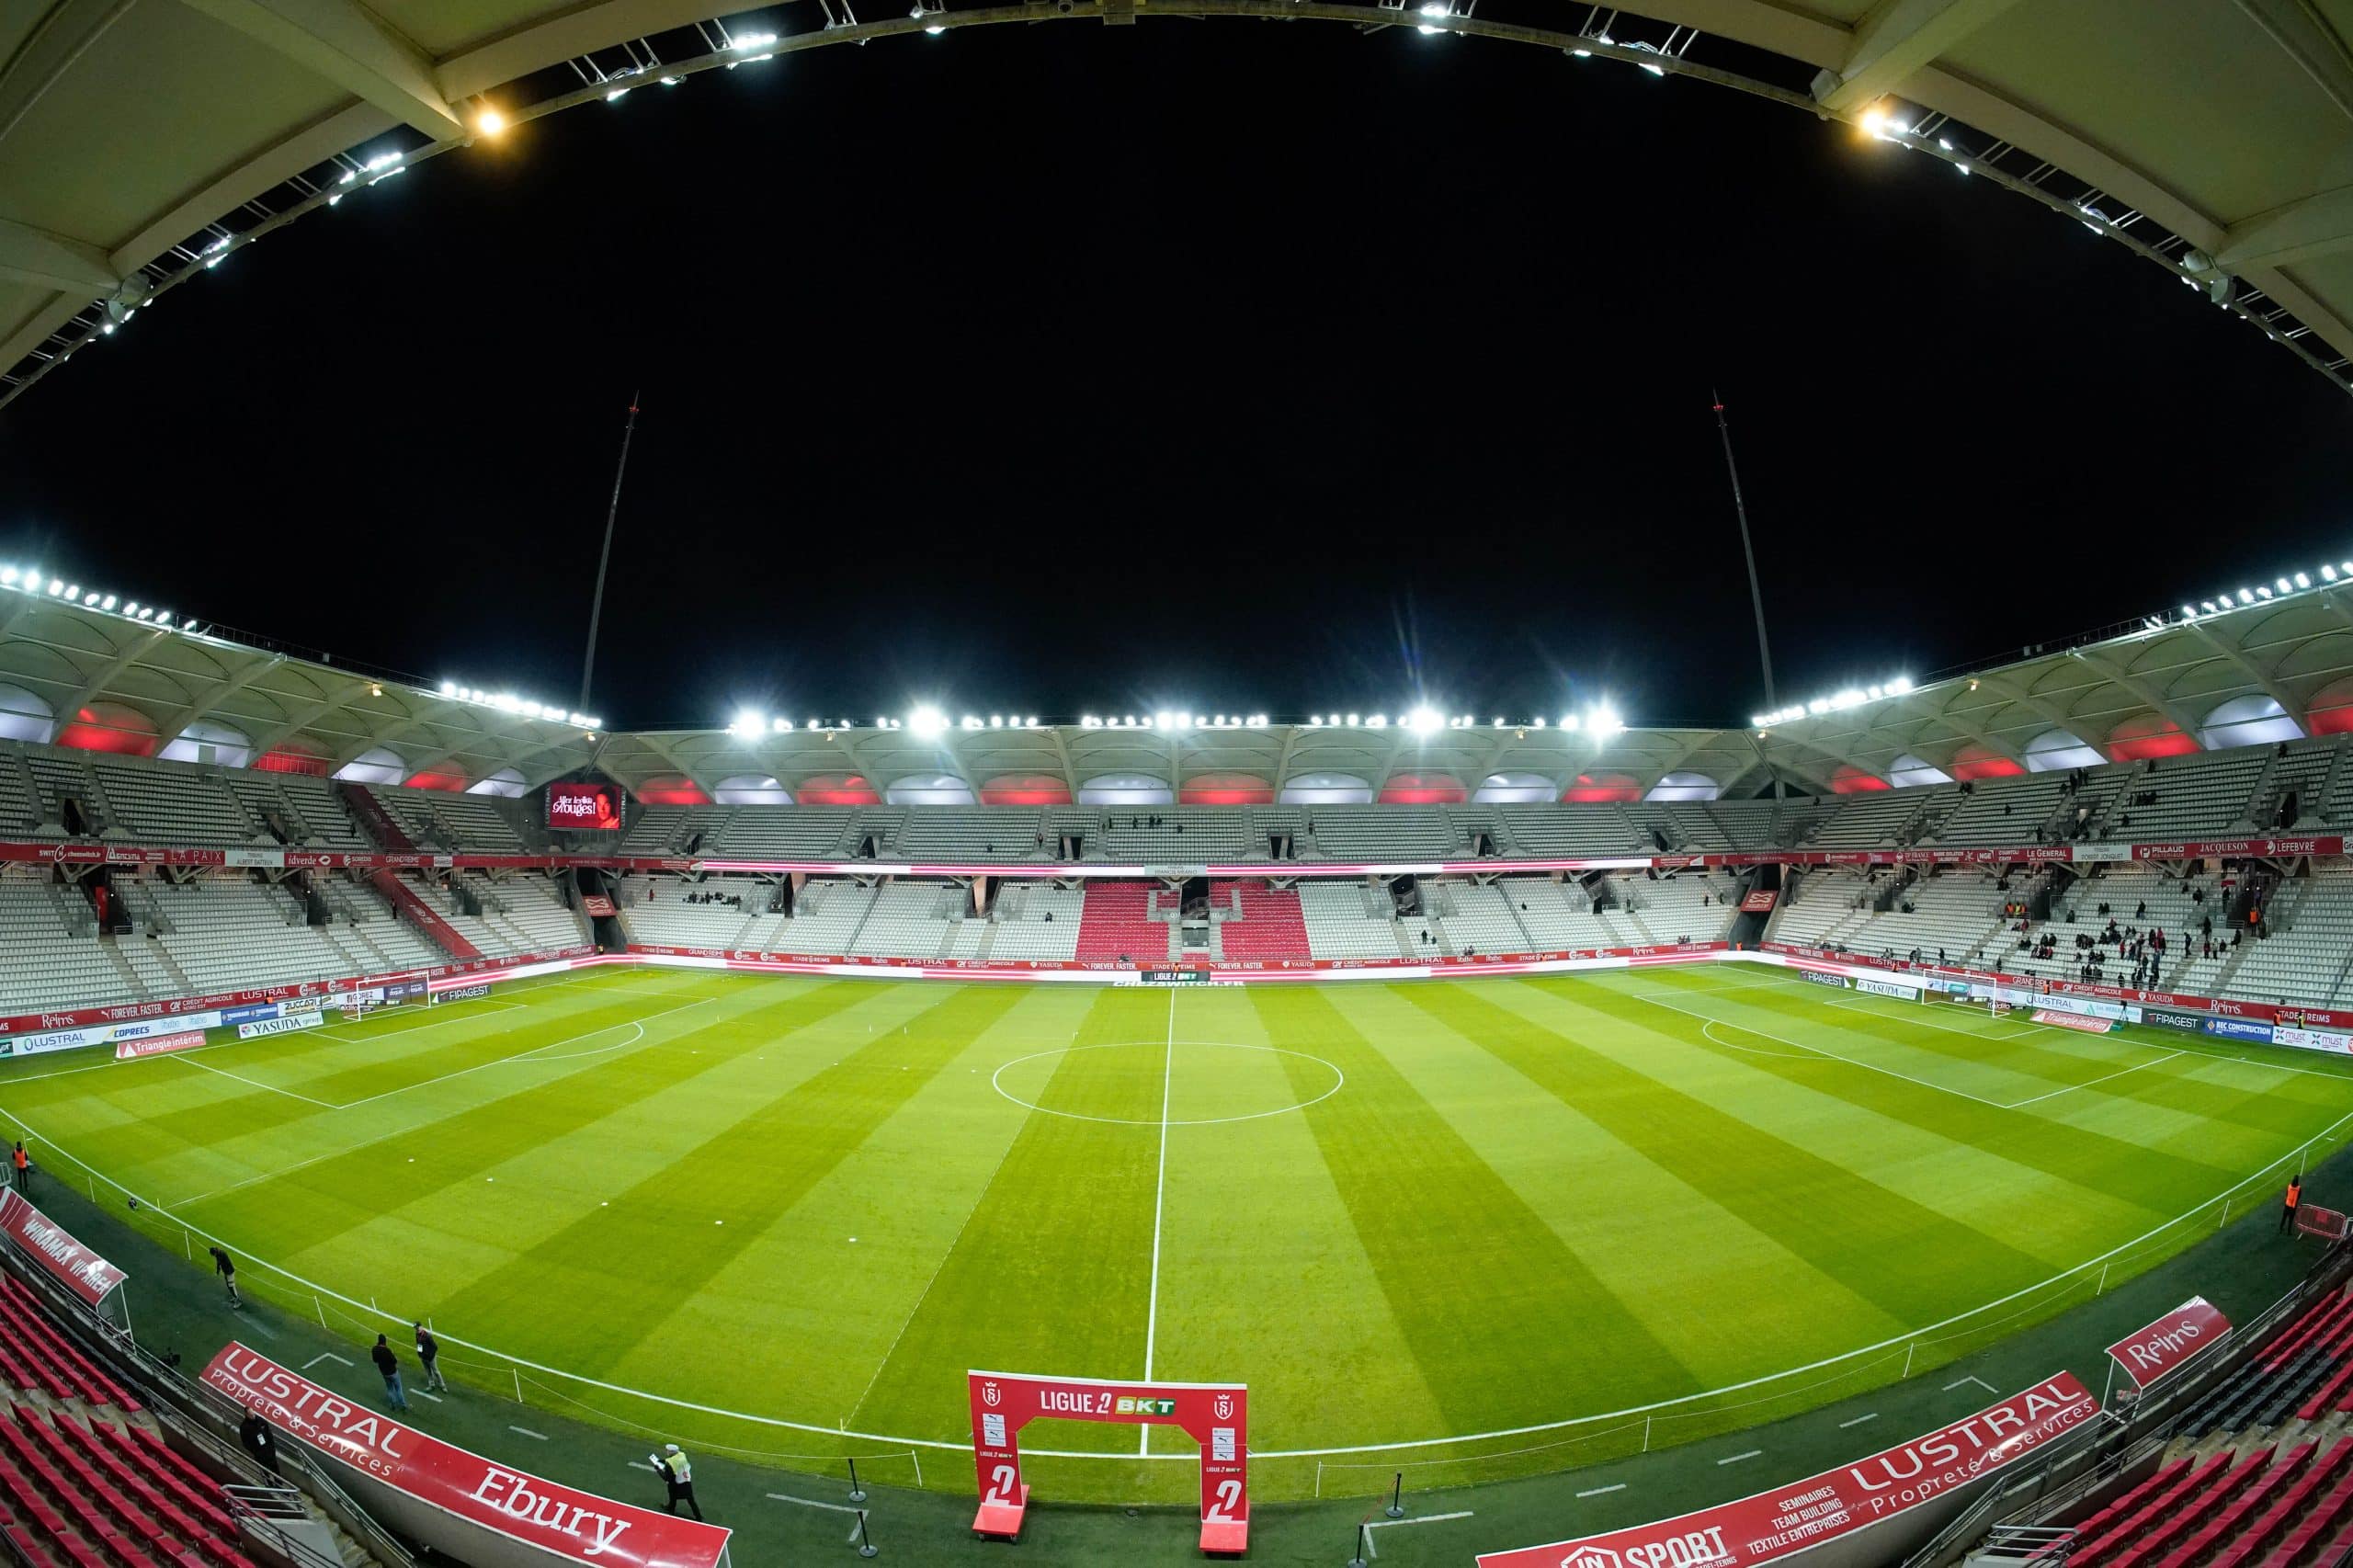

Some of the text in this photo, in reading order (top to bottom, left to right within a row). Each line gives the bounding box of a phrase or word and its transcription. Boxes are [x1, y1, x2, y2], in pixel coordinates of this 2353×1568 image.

[2152, 846, 2185, 854] PILLAUD
[2200, 841, 2249, 854] JACQUESON
[2277, 841, 2315, 853] LEFEBVRE
[193, 849, 222, 861] PAIX
[288, 854, 317, 866] idverde
[1090, 962, 1138, 971] FOREVER. FASTER.
[1217, 962, 1265, 971] FOREVER. FASTER.
[1399, 957, 1446, 965] LUSTRAL
[1807, 971, 1844, 987] FIPAGEST
[242, 986, 289, 1000] LUSTRAL
[449, 984, 489, 1001] FIPAGEST
[1866, 983, 1899, 996] YASUDA
[2094, 986, 2122, 996] AGRICOLE
[284, 998, 317, 1011] ZUCCARI
[2033, 995, 2075, 1008] LUSTRAL
[2147, 992, 2175, 1004] YASUDA
[110, 1003, 165, 1019] FOREVER. FASTER.
[2211, 999, 2242, 1016] Reims
[41, 1014, 74, 1029] Reims
[2155, 1013, 2199, 1028] FIPAGEST
[2306, 1013, 2331, 1023] REIMS
[114, 1026, 150, 1038] COPRECS
[253, 1017, 301, 1035] YASUDA
[2228, 1021, 2271, 1036] CONSTRUCTION
[31, 1032, 85, 1048] LUSTRAL
[2285, 1030, 2306, 1041] must
[2322, 1036, 2343, 1047] must
[22, 1218, 79, 1267] WINAMAX
[2127, 1320, 2200, 1369] Reims
[223, 1347, 403, 1460] LUSTRAL
[1040, 1390, 1176, 1415] LIGUE 2 BKT
[289, 1412, 302, 1429] &
[306, 1424, 392, 1477] Services
[1850, 1382, 2082, 1492] LUSTRAL
[1870, 1401, 2094, 1515] Propreté & Services
[984, 1464, 1016, 1507] 2
[1206, 1479, 1243, 1523] 2
[1779, 1485, 1836, 1513] SEMINAIRES
[469, 1466, 632, 1556] Ebury
[1770, 1497, 1843, 1530] TEAM BUILDING
[1746, 1510, 1851, 1555] TEXTILE ENTREPRISES
[1625, 1525, 1728, 1568] SPORT
